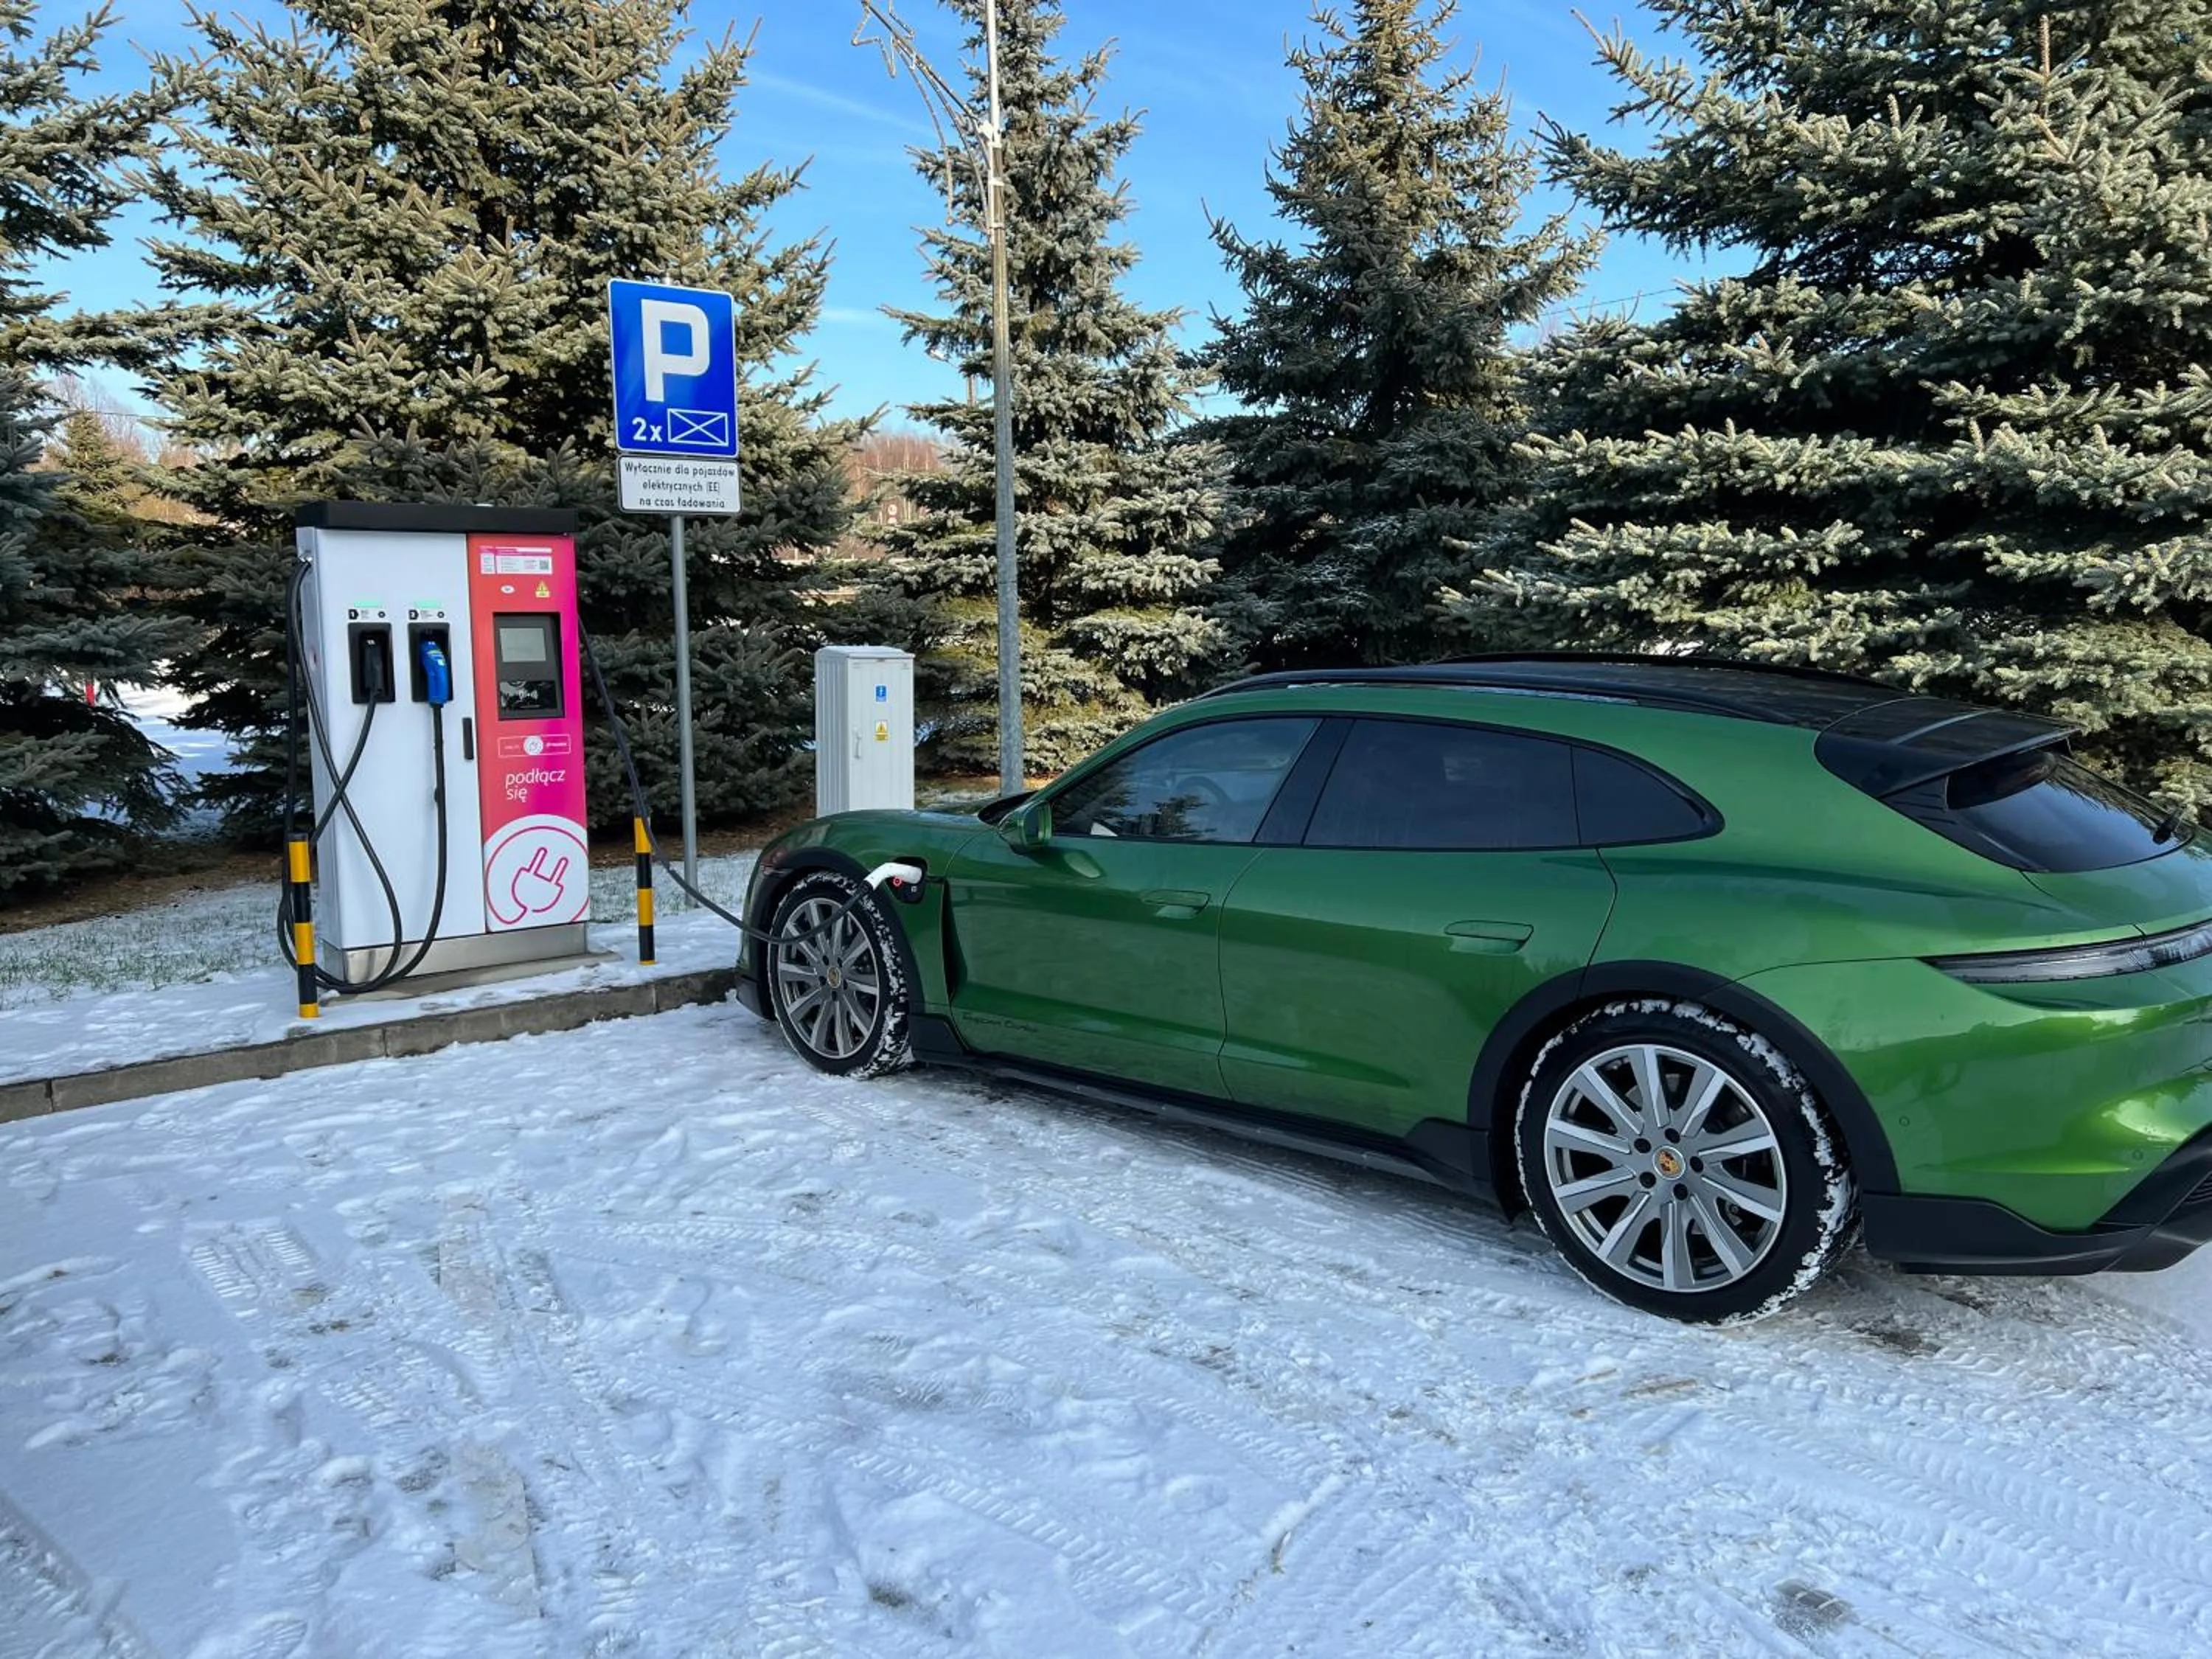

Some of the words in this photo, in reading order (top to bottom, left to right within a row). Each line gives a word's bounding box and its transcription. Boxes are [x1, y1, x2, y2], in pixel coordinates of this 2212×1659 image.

[641, 299, 710, 402] P
[632, 417, 663, 442] 2x
[675, 464, 689, 474] dla
[642, 479, 703, 493] elektrycznych
[639, 498, 651, 507] na
[655, 498, 674, 507] czas
[505, 768, 566, 789] podłącz
[507, 785, 527, 803] się
